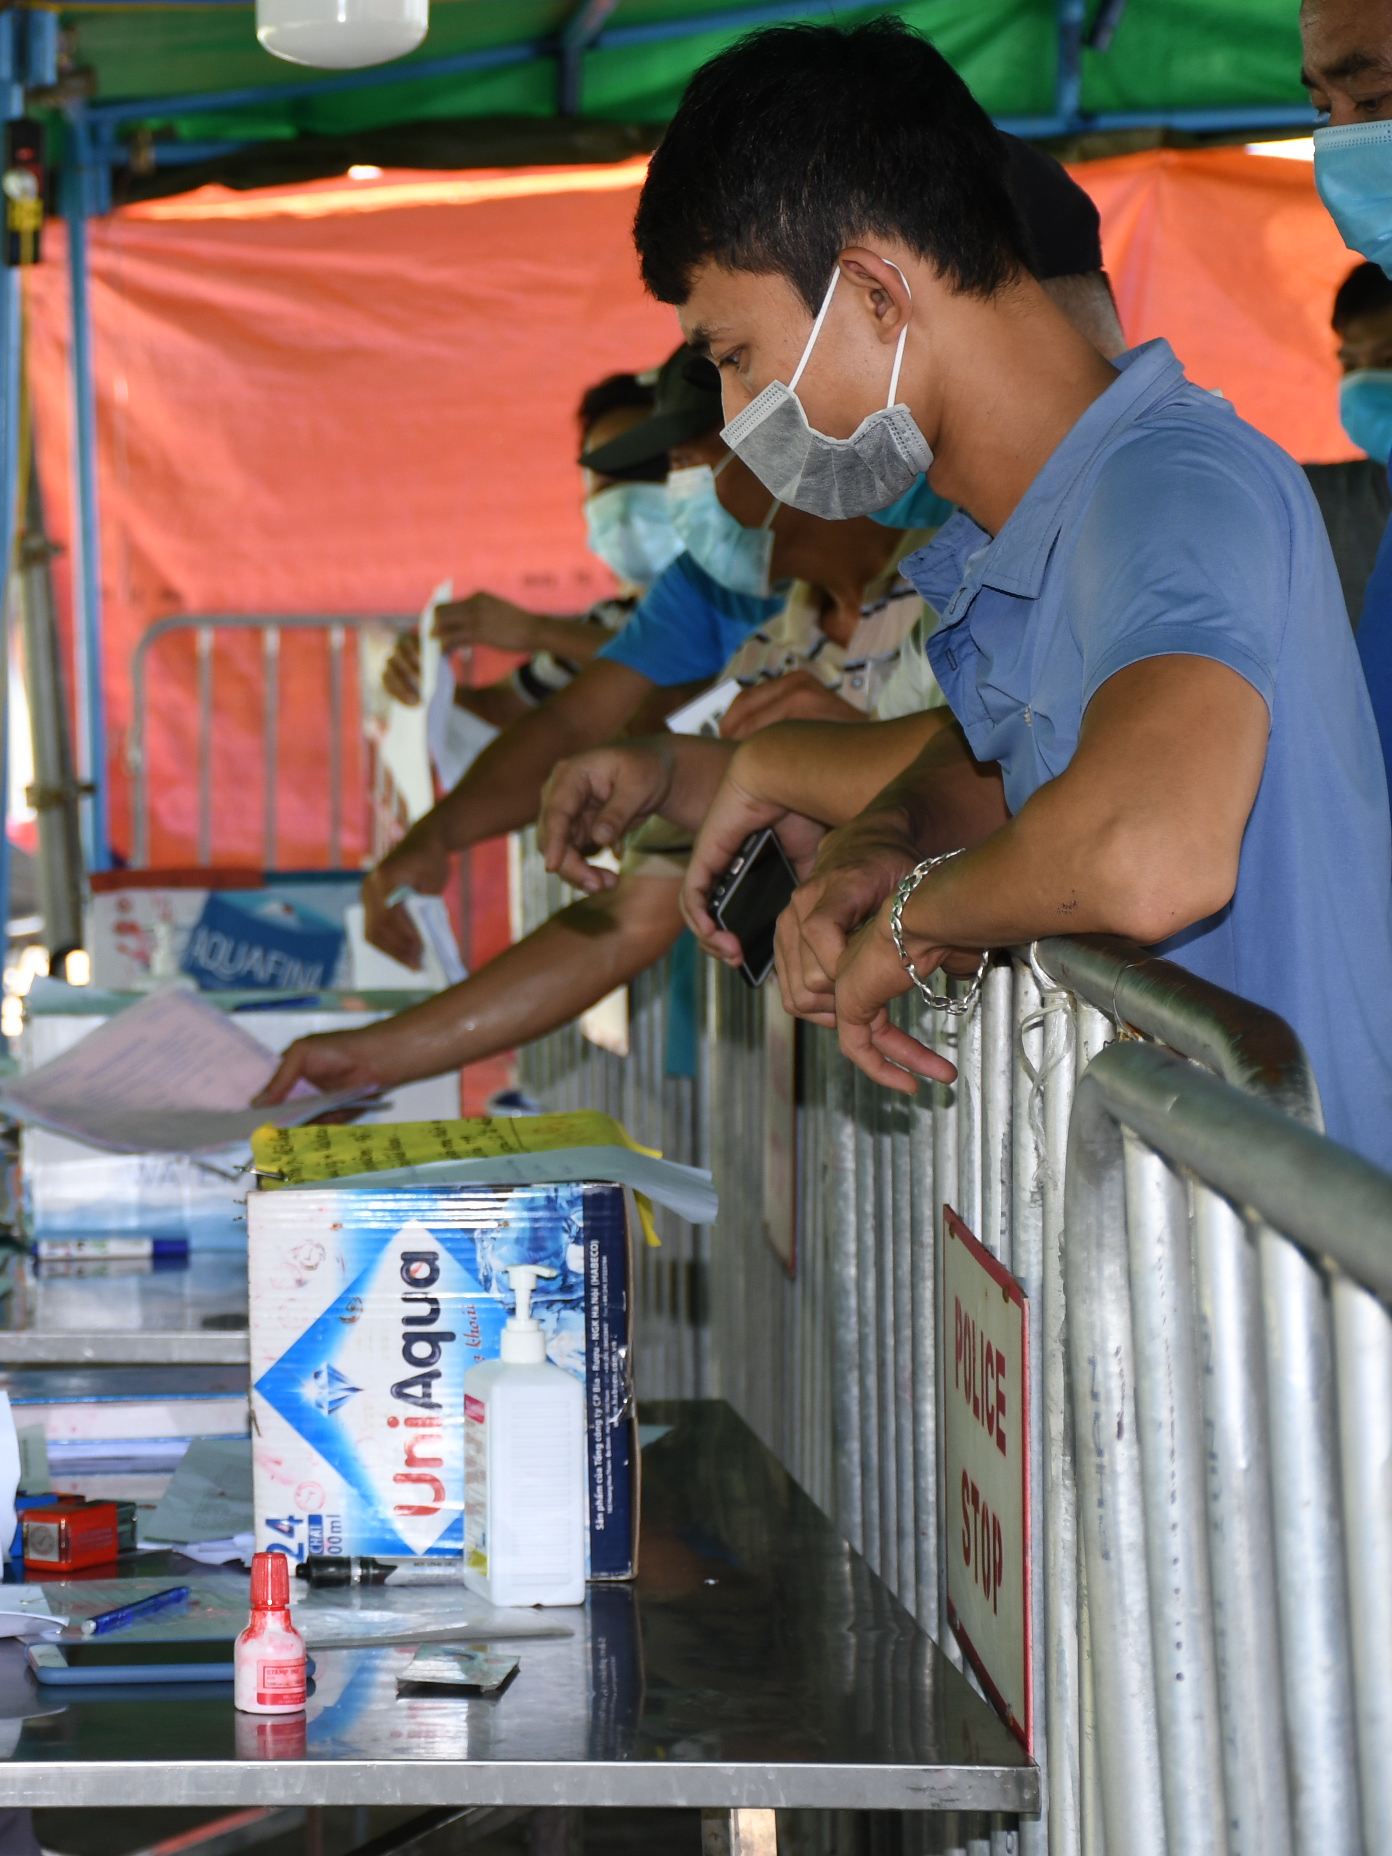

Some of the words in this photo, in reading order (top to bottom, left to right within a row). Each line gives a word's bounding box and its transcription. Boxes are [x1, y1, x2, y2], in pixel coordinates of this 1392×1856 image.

[589, 1239, 601, 1286] (HABECO)
[591, 1319, 600, 1341] NGK
[387, 1251, 457, 1517] UniAqua
[592, 1377, 601, 1393] Bia
[954, 1294, 1007, 1458] POLICE
[592, 1394, 602, 1407] CP
[265, 1514, 304, 1564] 24
[309, 1525, 323, 1555] CHAI
[325, 1514, 343, 1555] 00ml
[961, 1467, 1004, 1617] STOP
